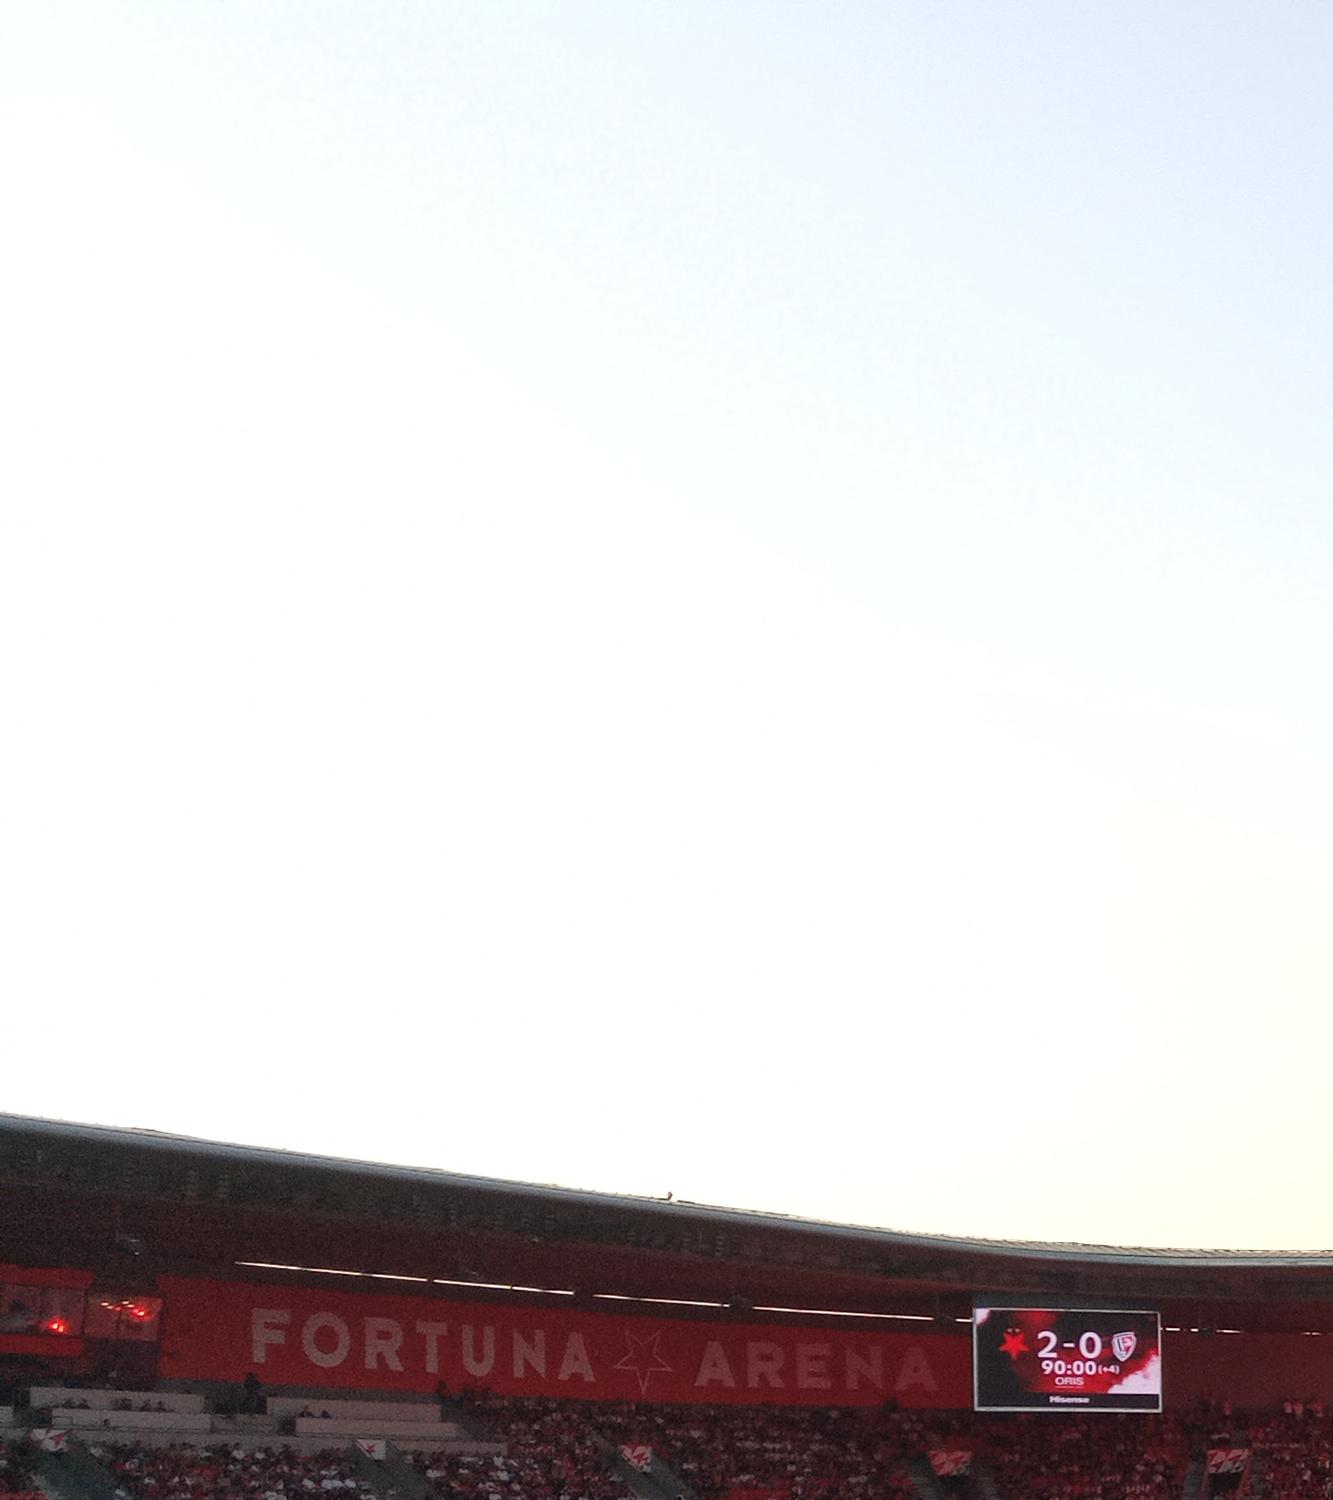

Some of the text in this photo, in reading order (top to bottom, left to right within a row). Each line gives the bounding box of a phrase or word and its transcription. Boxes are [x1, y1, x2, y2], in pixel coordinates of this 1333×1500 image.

[252, 1308, 939, 1391] FORTUNA ARENA
[1041, 1360, 1097, 1375] 90:00
